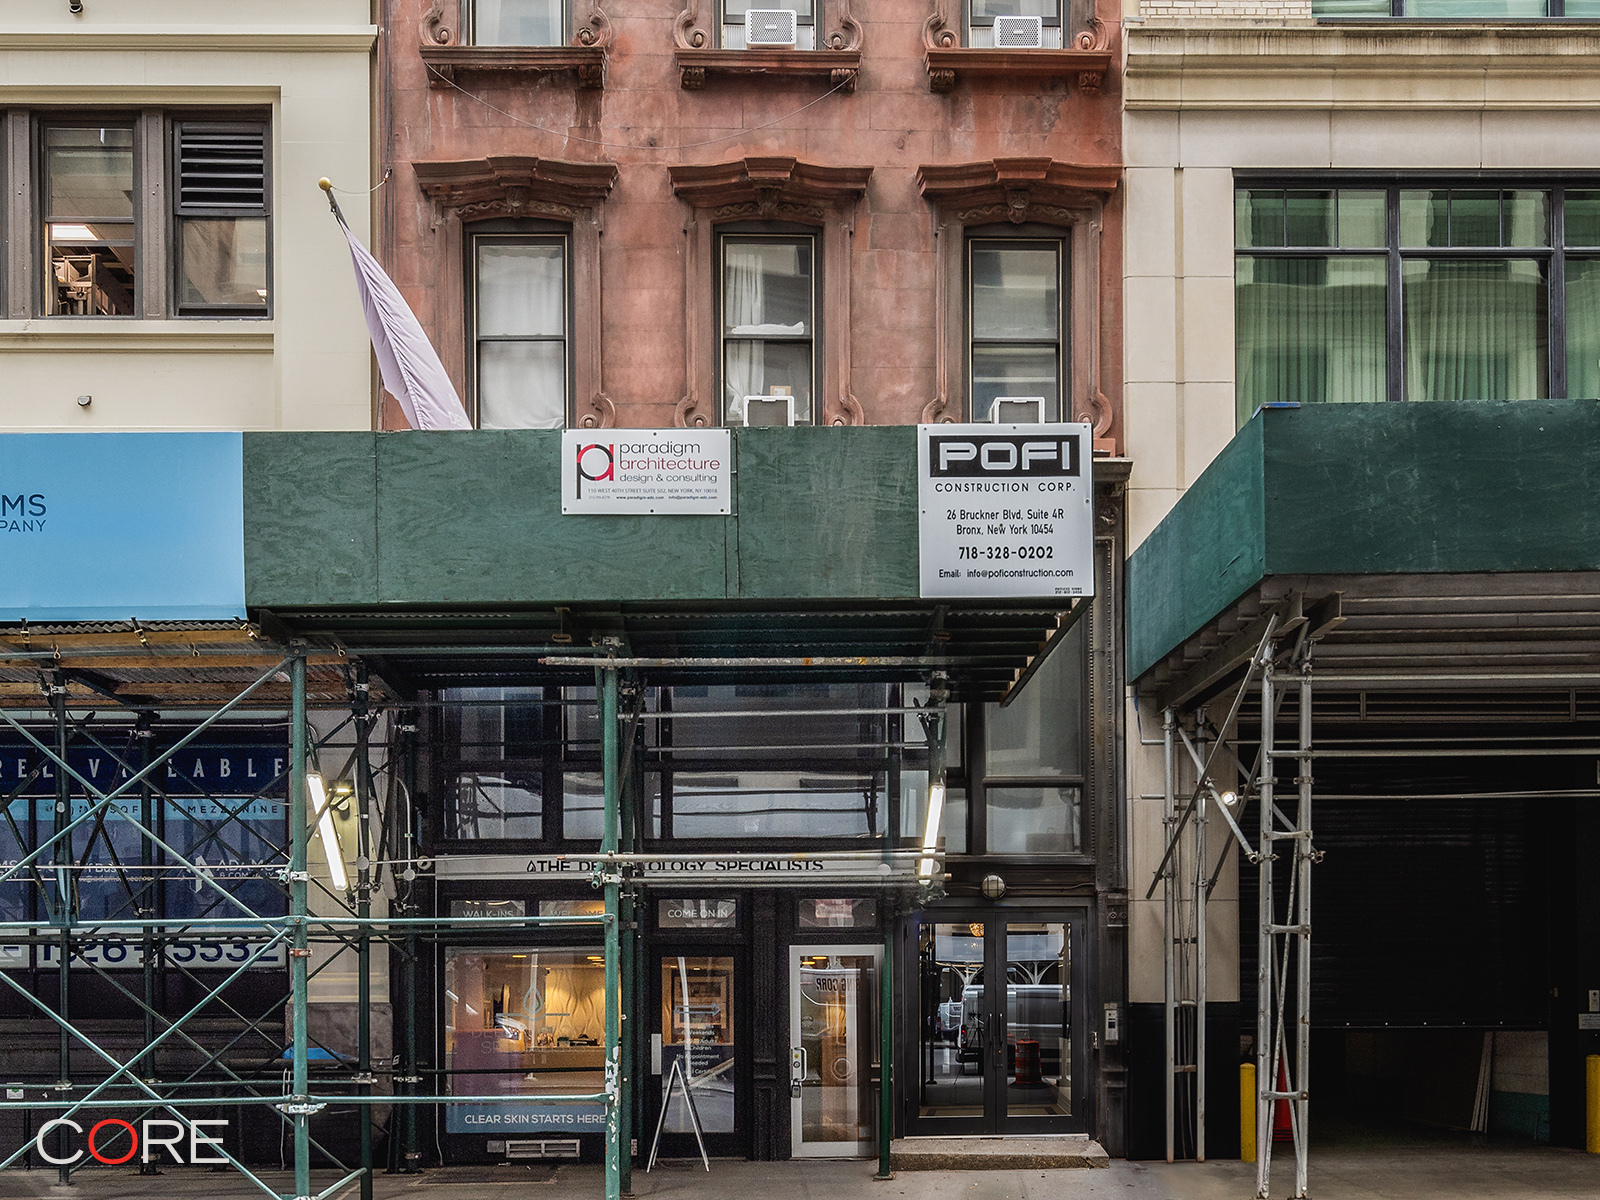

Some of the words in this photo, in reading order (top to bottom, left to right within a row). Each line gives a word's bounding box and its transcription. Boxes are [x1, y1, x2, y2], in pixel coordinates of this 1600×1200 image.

[620, 441, 700, 461] paradigm
[939, 441, 1070, 471] POFI
[620, 458, 720, 470] architecture
[620, 474, 653, 485] design
[656, 474, 663, 482] &
[666, 474, 718, 485] consulting
[935, 483, 1029, 493] CONSTRUCTION
[1038, 483, 1076, 492] CORP.
[2, 494, 47, 516] MS
[947, 510, 956, 520] 26
[960, 509, 999, 520] Bruckner
[1003, 509, 1024, 521] Blvd,
[1027, 509, 1049, 520] Suite
[1052, 509, 1064, 520] 4R
[956, 525, 984, 536] Bronx,
[987, 524, 1006, 535] New
[1009, 524, 1028, 535] York
[1031, 524, 1054, 535] 10454
[959, 546, 1053, 559] 718-328-0202
[939, 569, 962, 578] Email:
[967, 569, 1074, 579] info@poficonstruction.com
[537, 860, 570, 872] THE
[715, 860, 824, 871] SPECIALISTS
[668, 909, 697, 918] COME
[700, 909, 715, 918] ON
[717, 909, 728, 918] IN
[465, 1114, 501, 1124] CLEAR
[504, 1114, 529, 1124] SKIN
[532, 1114, 574, 1124] STARTS
[577, 1114, 606, 1124] HERE
